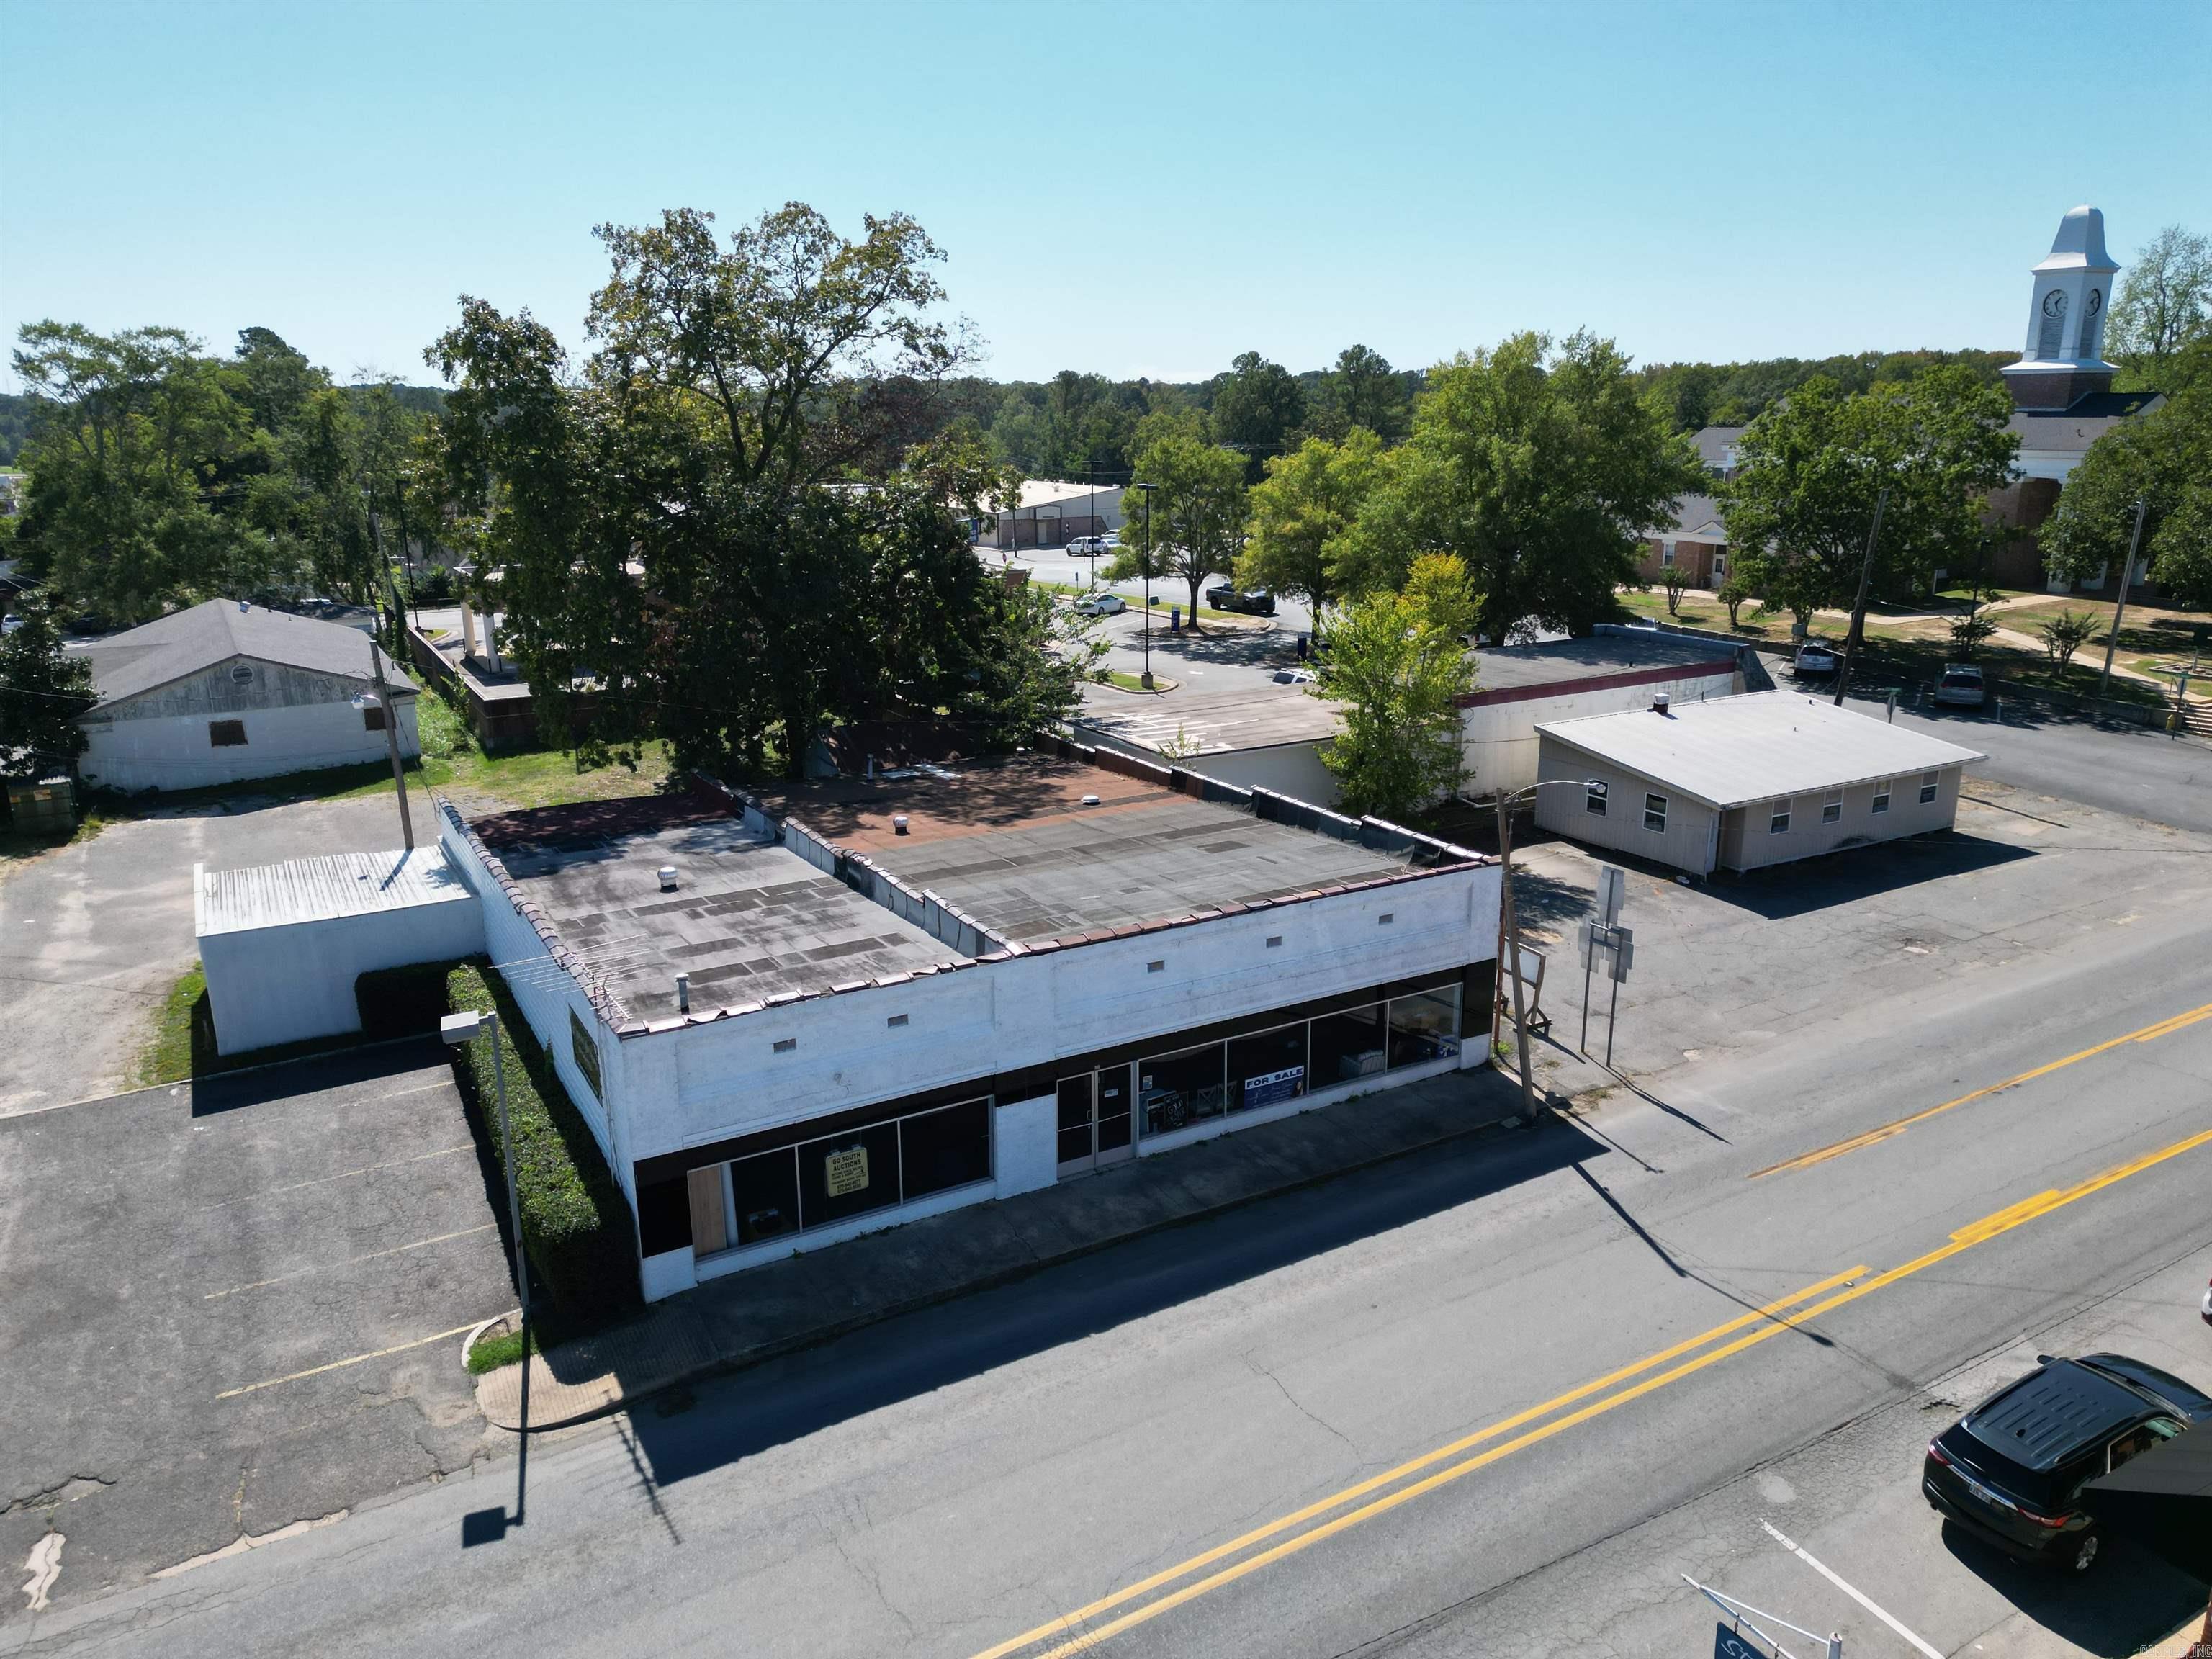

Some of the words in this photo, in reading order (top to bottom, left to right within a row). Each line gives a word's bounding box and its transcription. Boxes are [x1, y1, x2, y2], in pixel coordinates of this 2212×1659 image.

[1246, 1077, 1269, 1089] FOR
[1274, 1067, 1303, 1081] SALE
[842, 1152, 861, 1162] SOUTH
[834, 1159, 861, 1172] AUCTIONS
